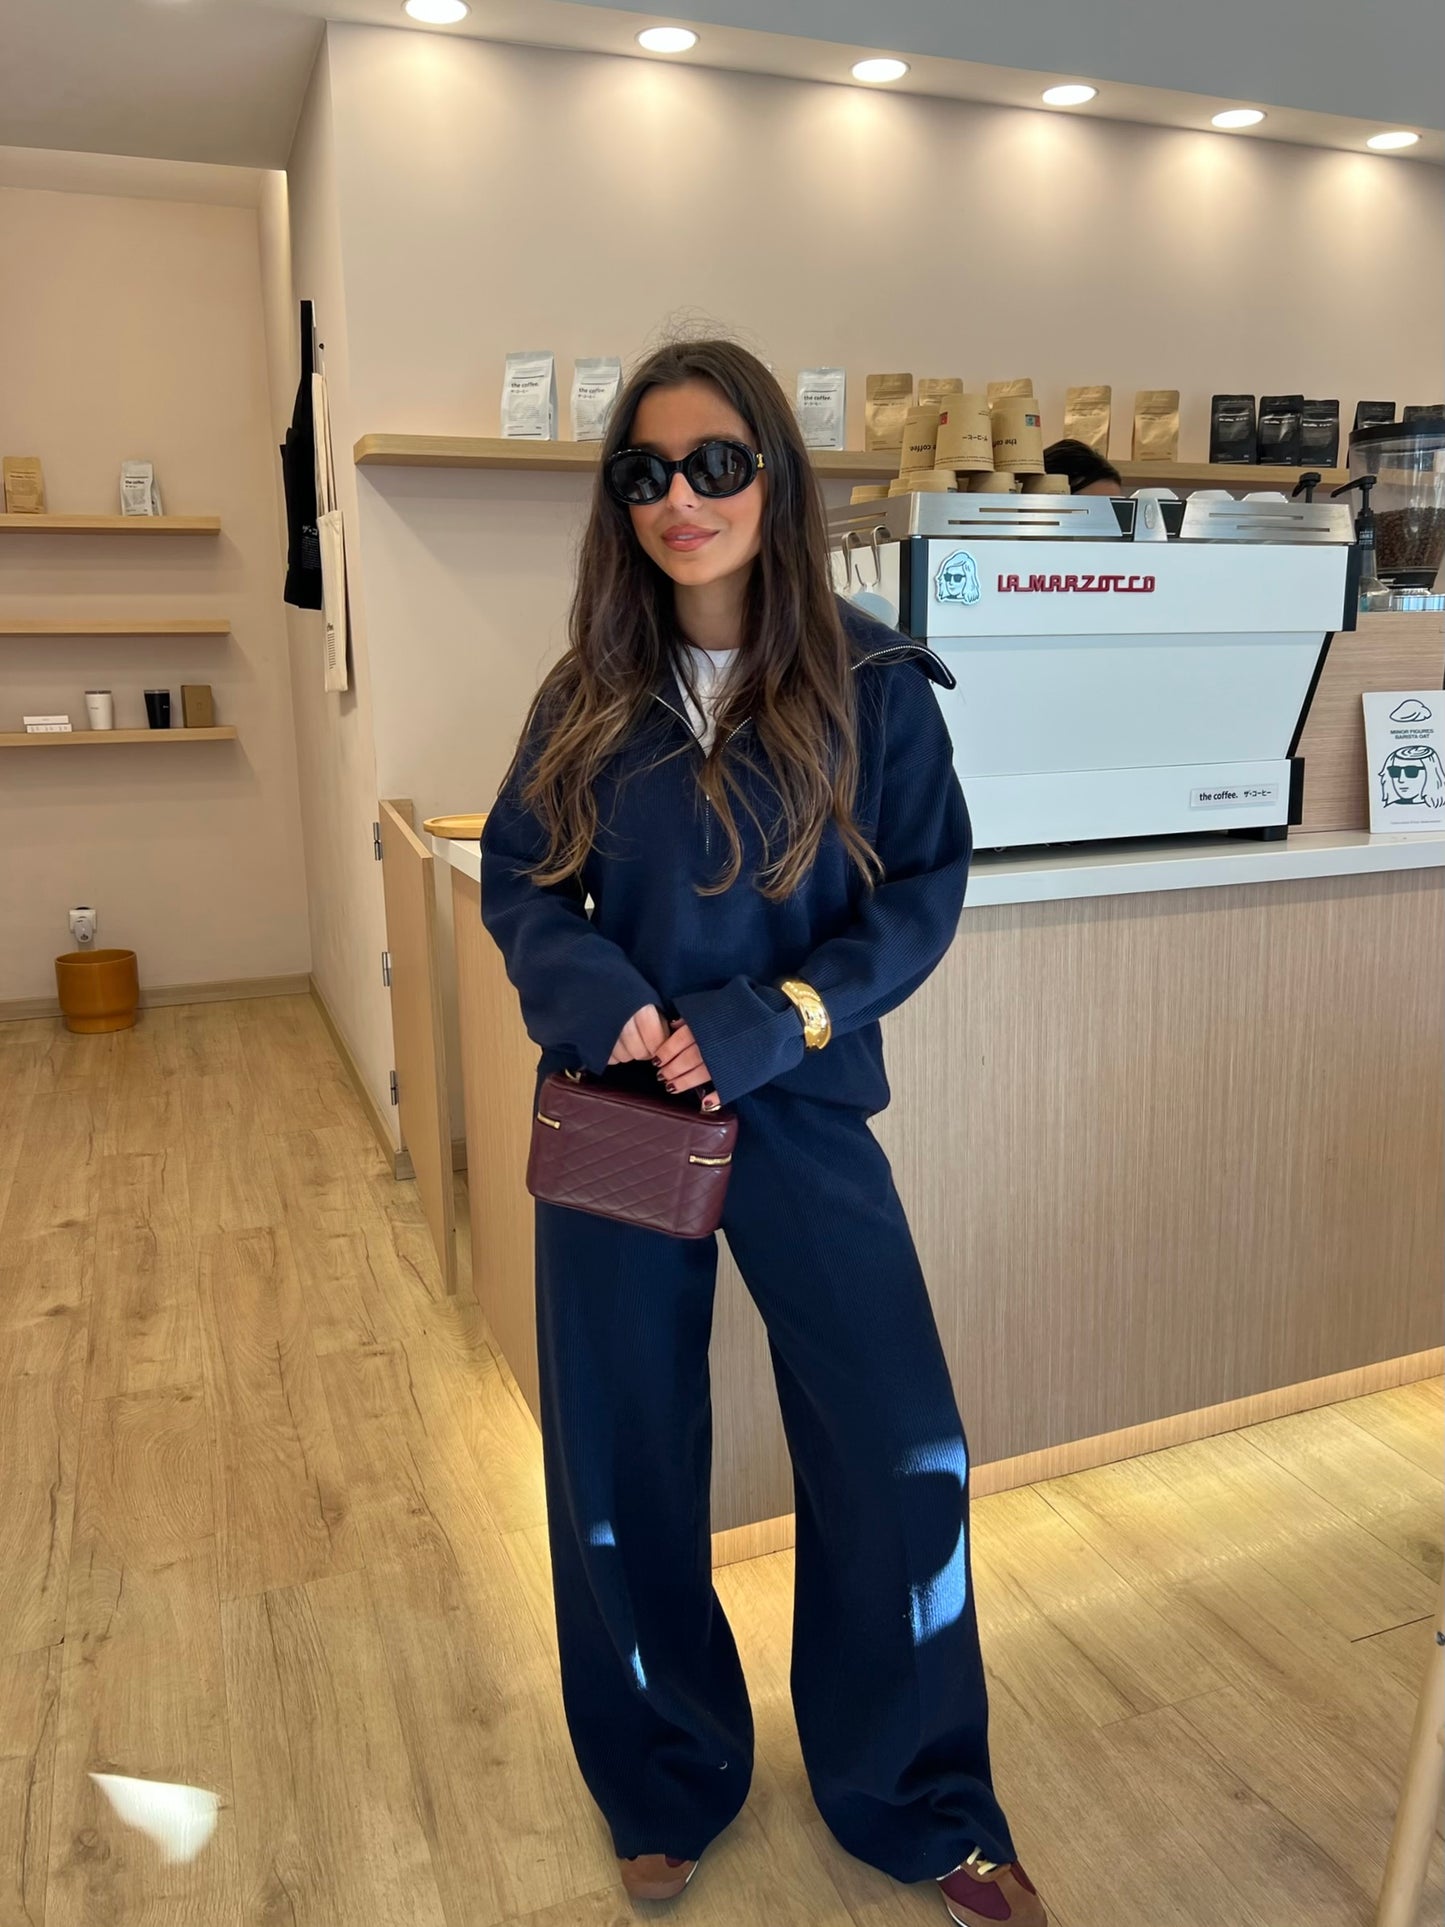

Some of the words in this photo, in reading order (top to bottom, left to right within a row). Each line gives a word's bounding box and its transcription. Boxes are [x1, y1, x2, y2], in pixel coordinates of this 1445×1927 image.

[1004, 438, 1016, 446] the
[998, 574, 1020, 592] LA
[1030, 574, 1156, 592] MARZOCCO
[1200, 792, 1212, 801] the
[1213, 790, 1238, 800] coffee.
